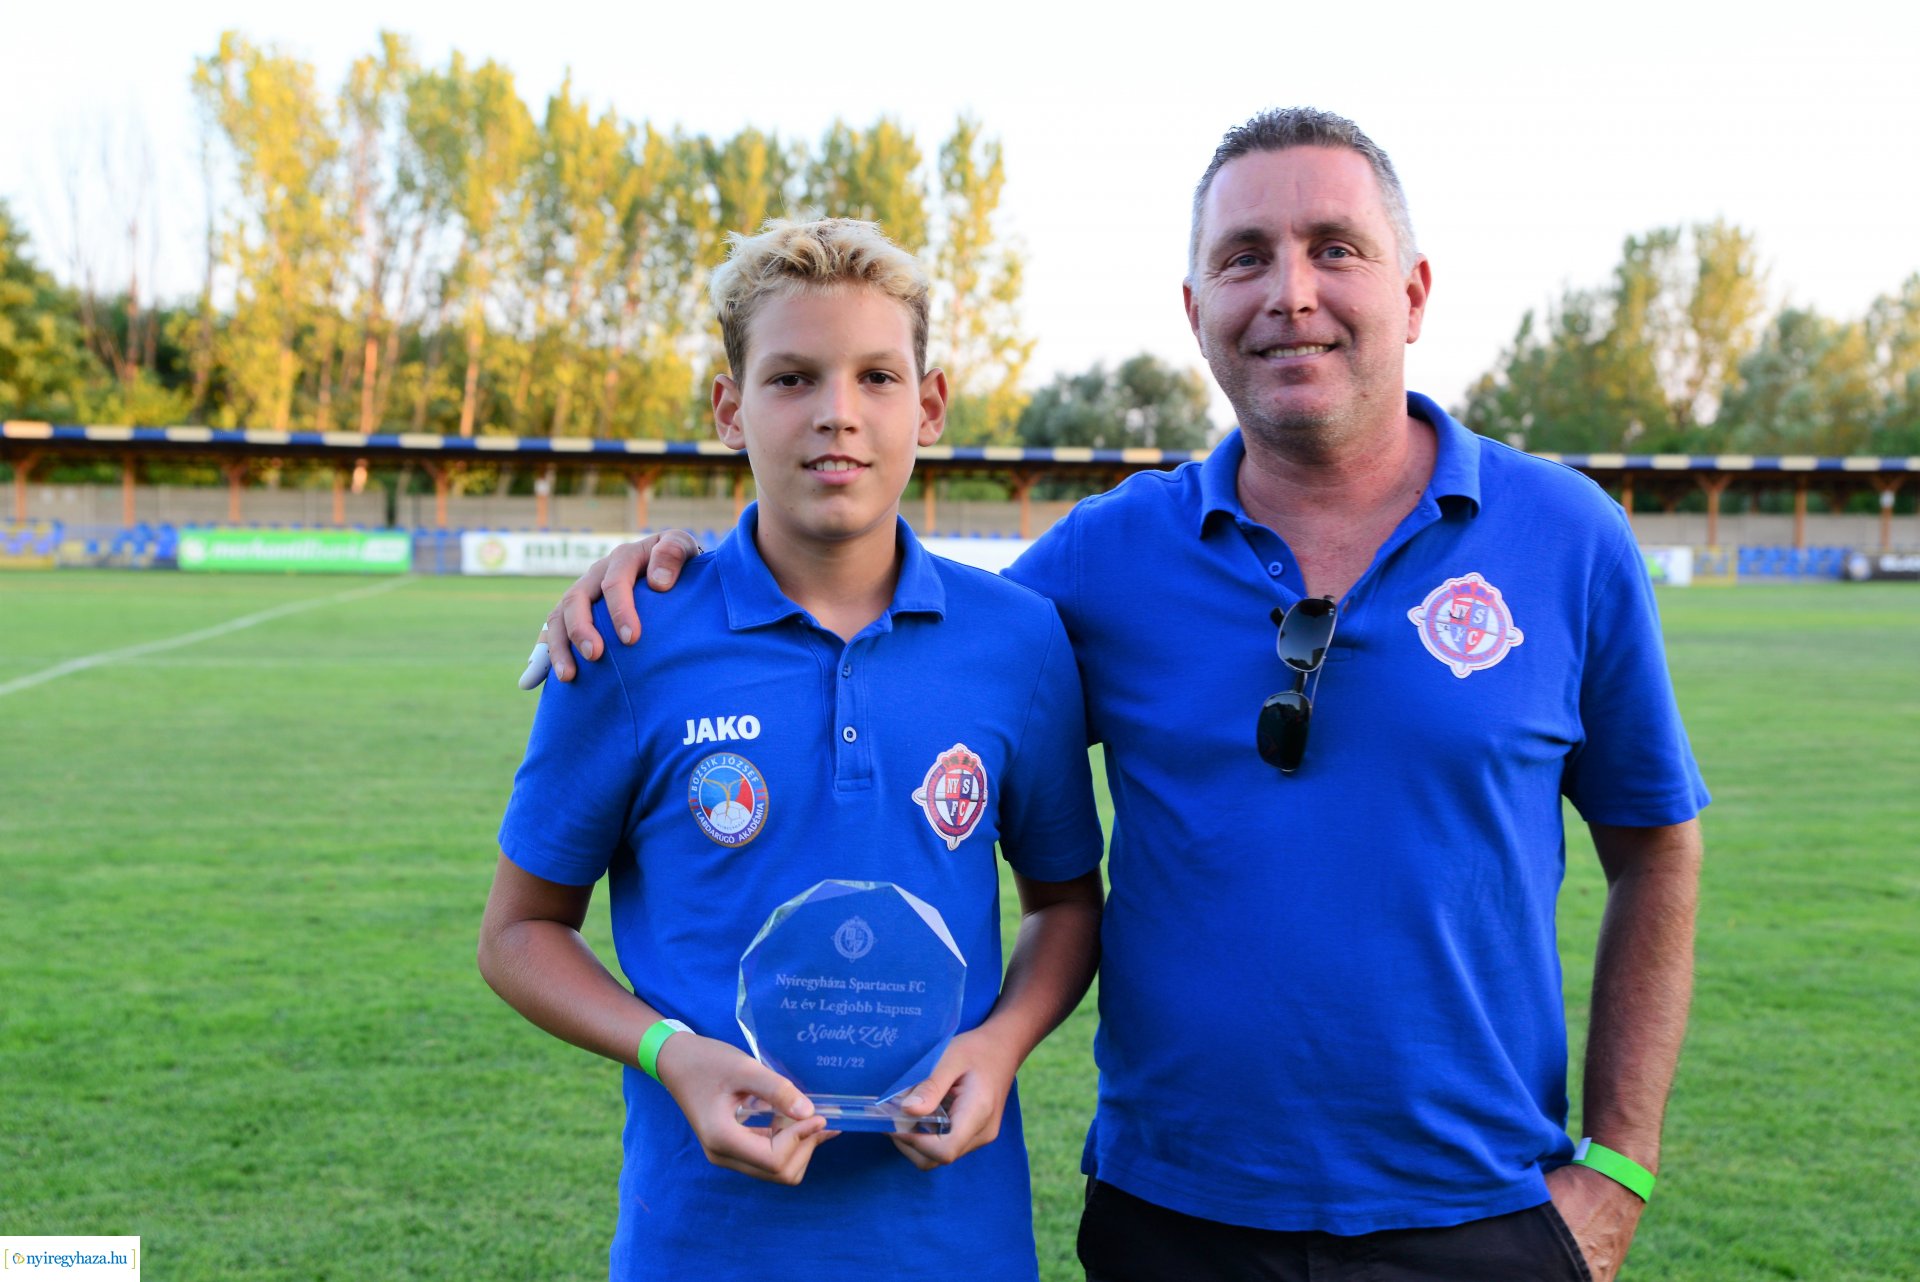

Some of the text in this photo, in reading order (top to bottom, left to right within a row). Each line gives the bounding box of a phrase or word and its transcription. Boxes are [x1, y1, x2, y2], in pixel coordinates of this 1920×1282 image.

[682, 715, 761, 745] JAKO
[691, 756, 759, 792] BOZSIK JÓZSEF
[947, 778, 971, 794] NY S
[951, 801, 966, 816] F C
[696, 802, 765, 844] LABDARÚGÓ AKADÉMIA
[775, 973, 926, 993] Nyíregyháza Spartacus FC
[780, 997, 922, 1018] Az év Legjobb kapusa
[797, 1022, 856, 1045] Novák
[816, 1055, 865, 1069] 2021/22
